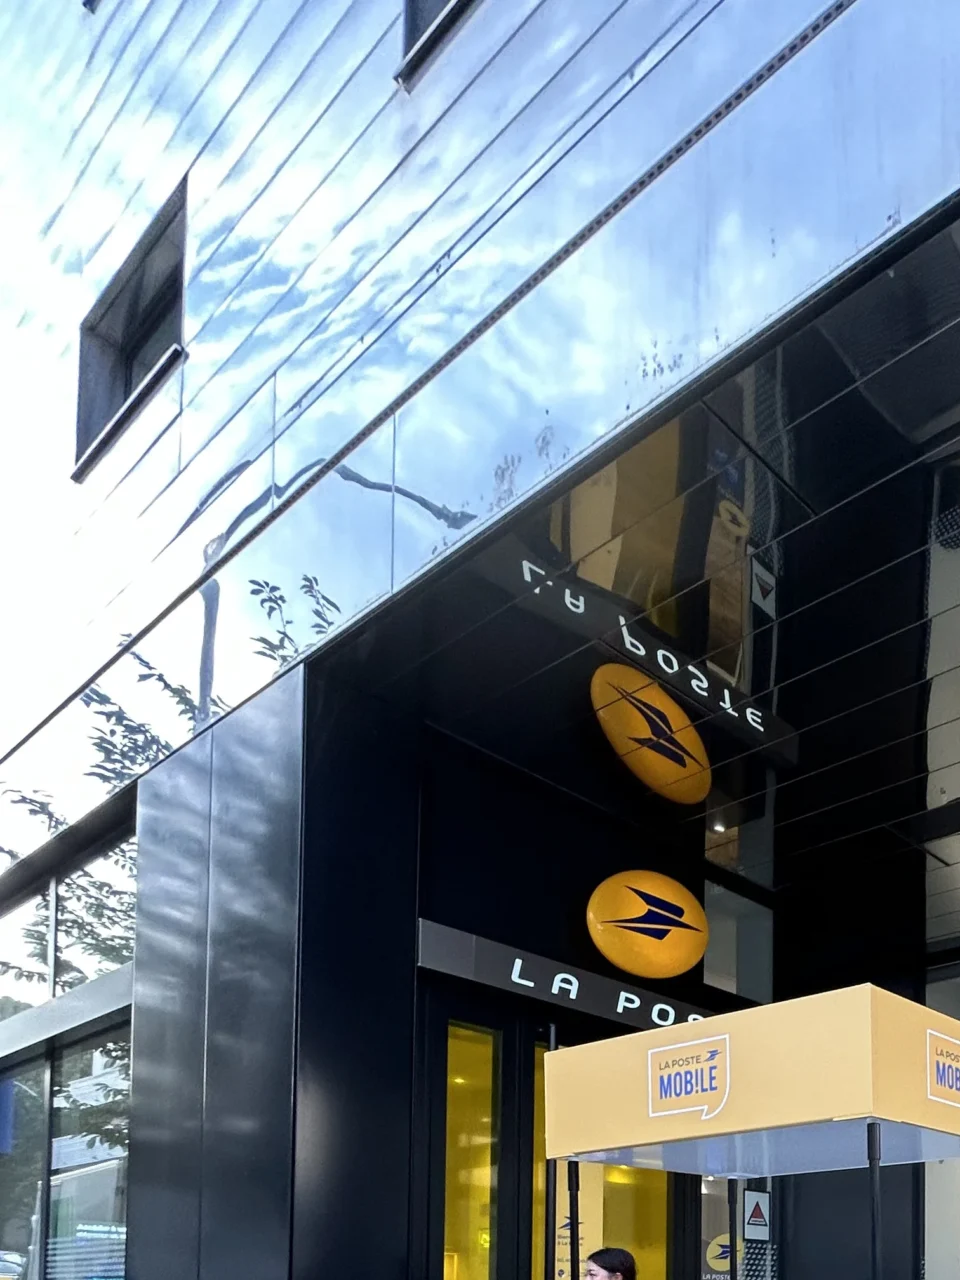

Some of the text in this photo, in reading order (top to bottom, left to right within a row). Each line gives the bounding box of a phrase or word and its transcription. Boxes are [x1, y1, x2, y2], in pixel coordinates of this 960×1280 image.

[511, 958, 580, 1000] LA
[935, 1046, 945, 1057] LA
[658, 1055, 702, 1071] LA POSTE
